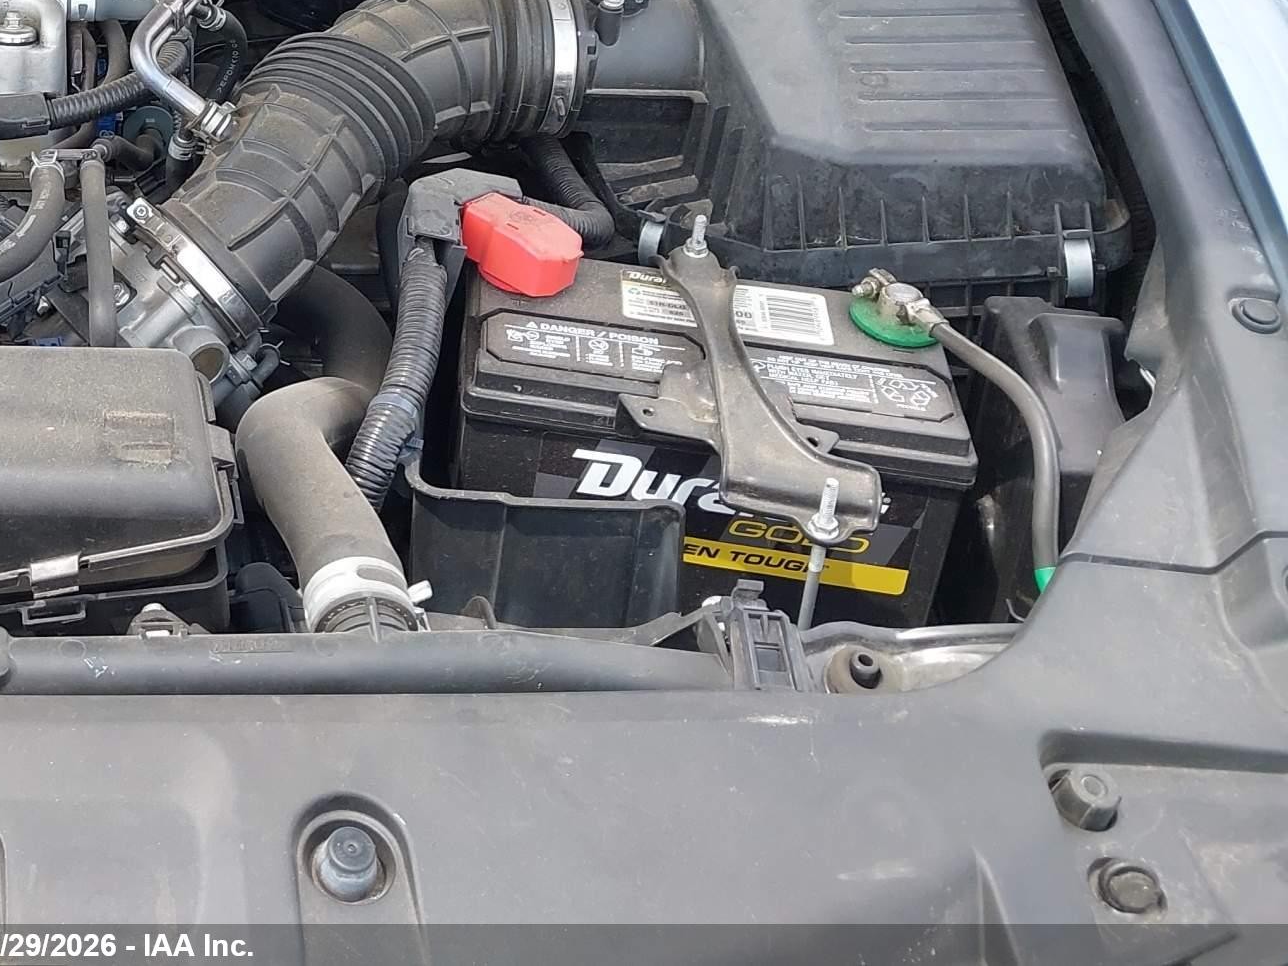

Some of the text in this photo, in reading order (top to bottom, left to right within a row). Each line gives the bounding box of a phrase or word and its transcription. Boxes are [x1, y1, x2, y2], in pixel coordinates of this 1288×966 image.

[540, 323, 595, 337] DANGER
[607, 332, 659, 345] POISON
[572, 449, 754, 518] Dura
[728, 520, 870, 553] GOD
[730, 551, 828, 574] TOUG
